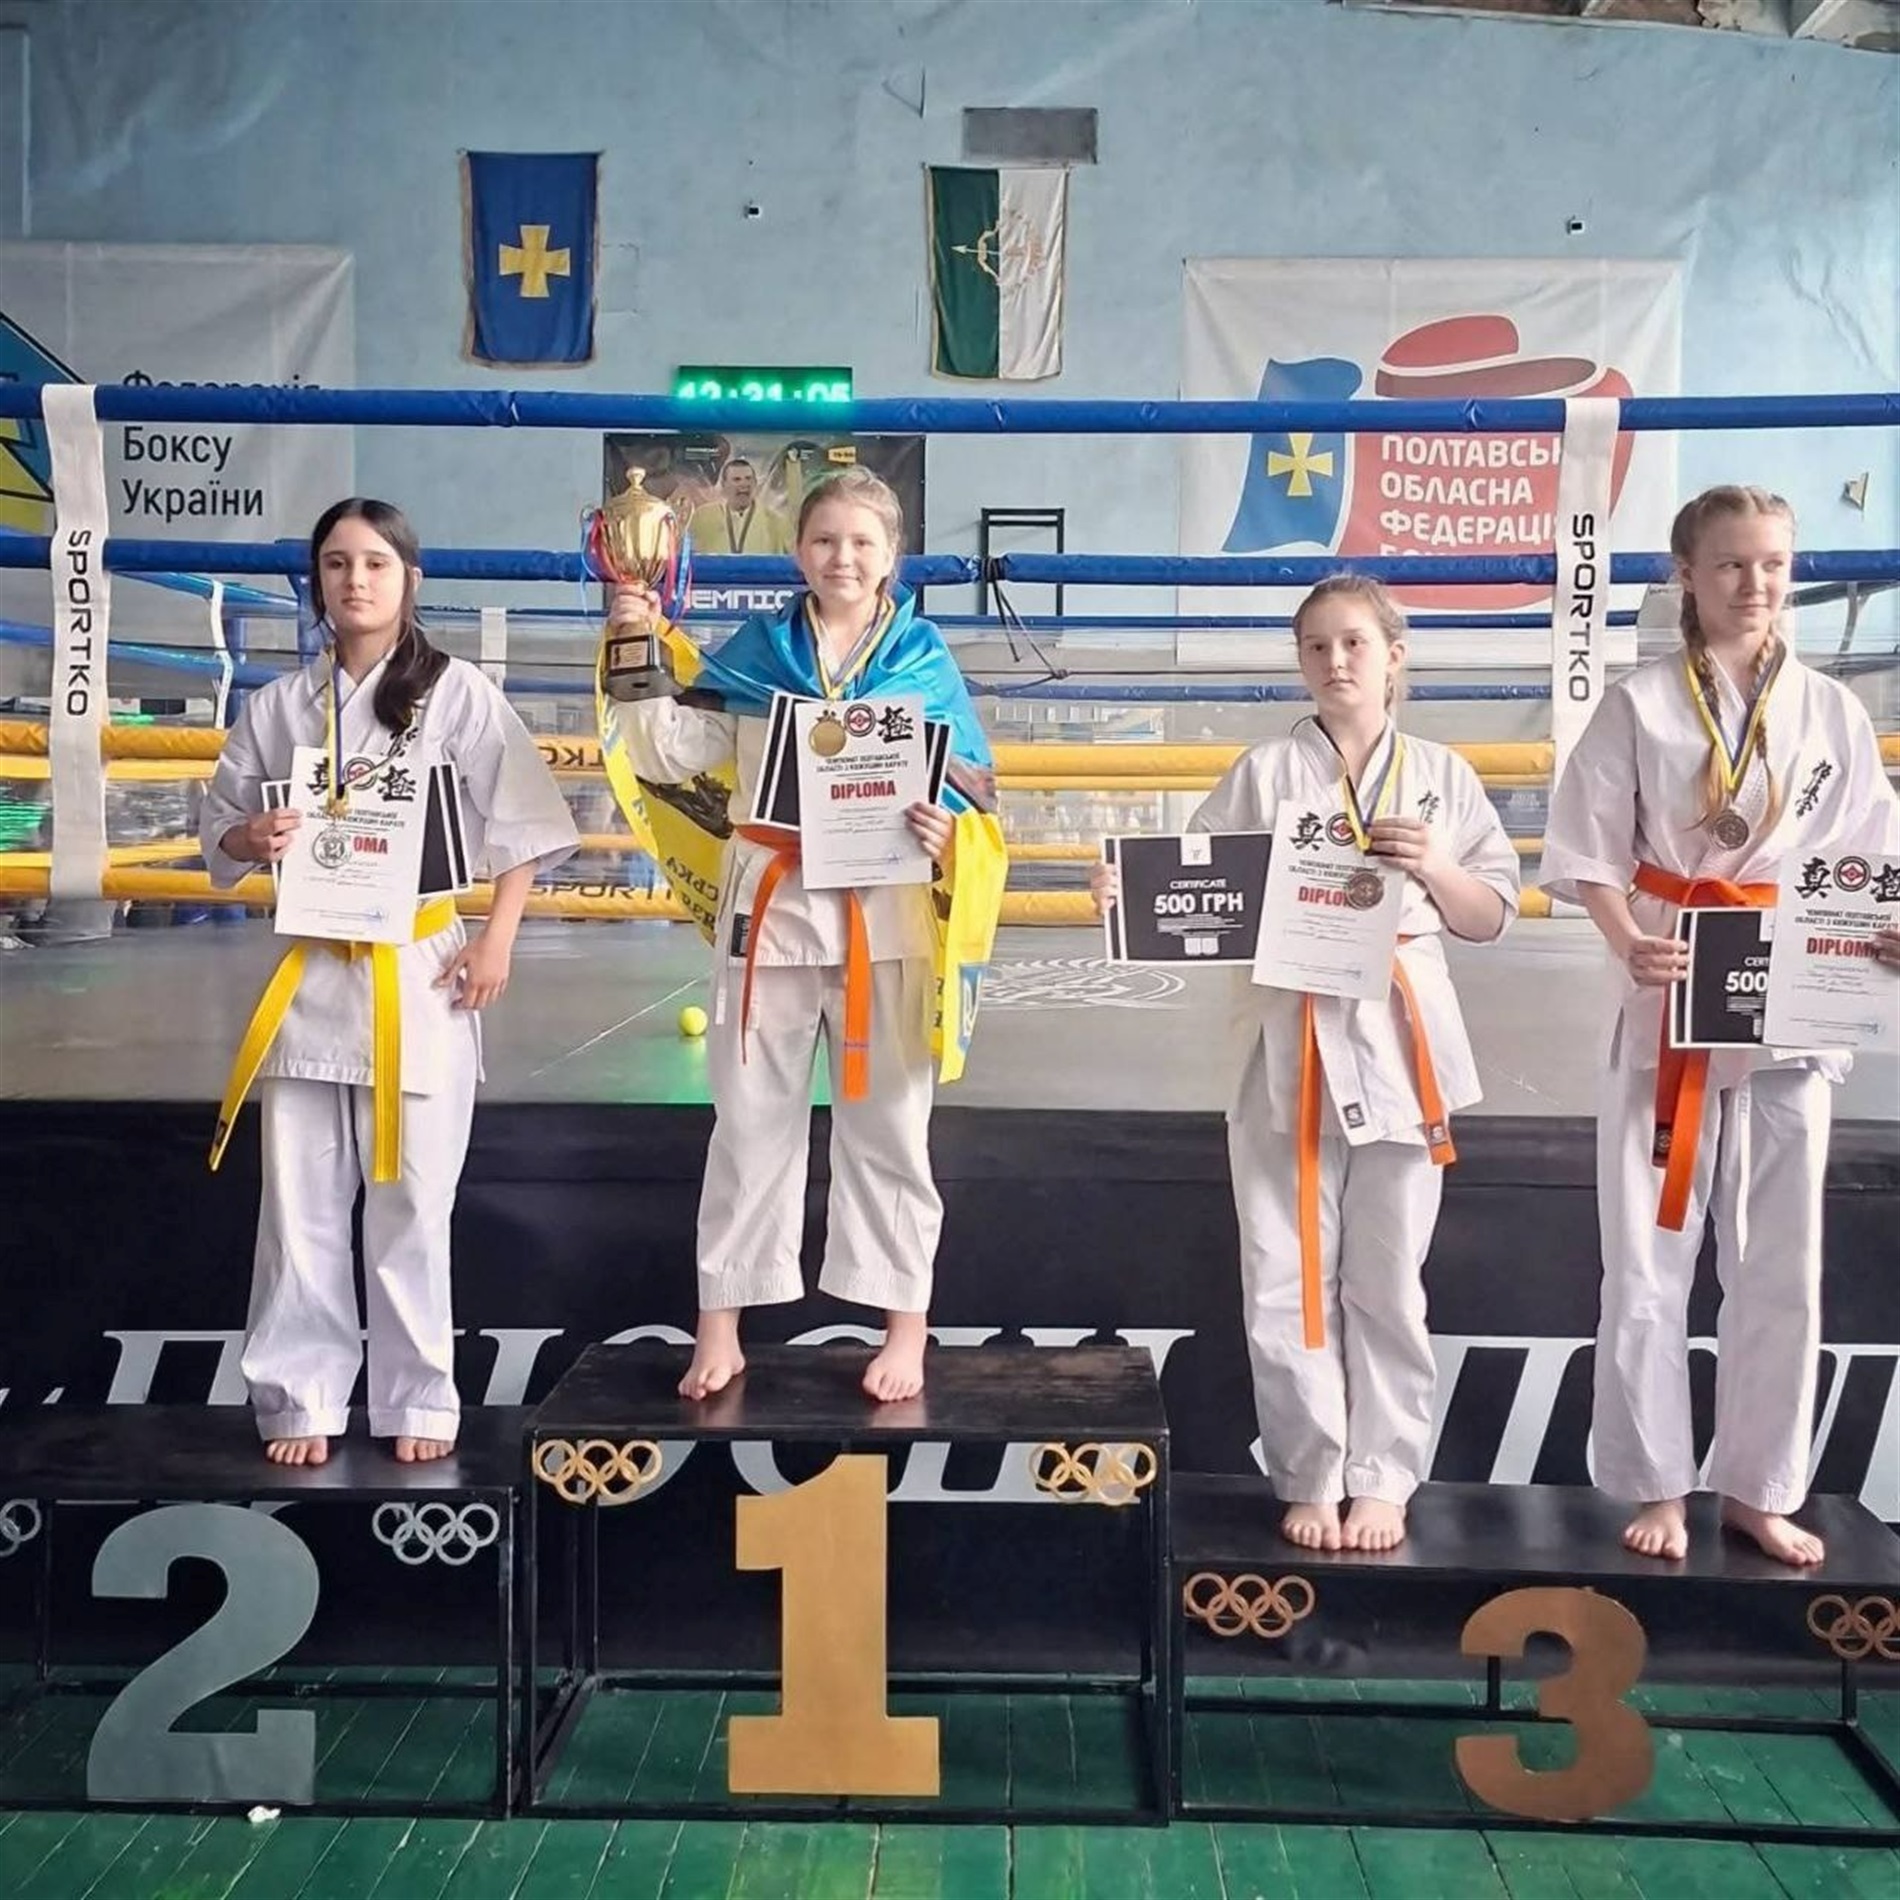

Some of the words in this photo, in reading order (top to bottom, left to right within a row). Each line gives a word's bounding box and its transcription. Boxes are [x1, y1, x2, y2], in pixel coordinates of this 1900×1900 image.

[124, 426, 232, 472] Боксу
[122, 479, 263, 523] України
[1380, 471, 1533, 506] ОБЛАСНА
[1379, 509, 1557, 547] ФЕДЕРАЦІ
[66, 529, 93, 717] SPORTKO
[1568, 513, 1596, 702] SPORTKO
[830, 780, 896, 800] DIPLOMA
[1154, 893, 1196, 914] 500
[1202, 892, 1244, 912] ГРН
[1725, 971, 1768, 992] 500
[727, 1455, 941, 1797] 1
[87, 1505, 320, 1806] 2
[1454, 1587, 1656, 1821] 3
